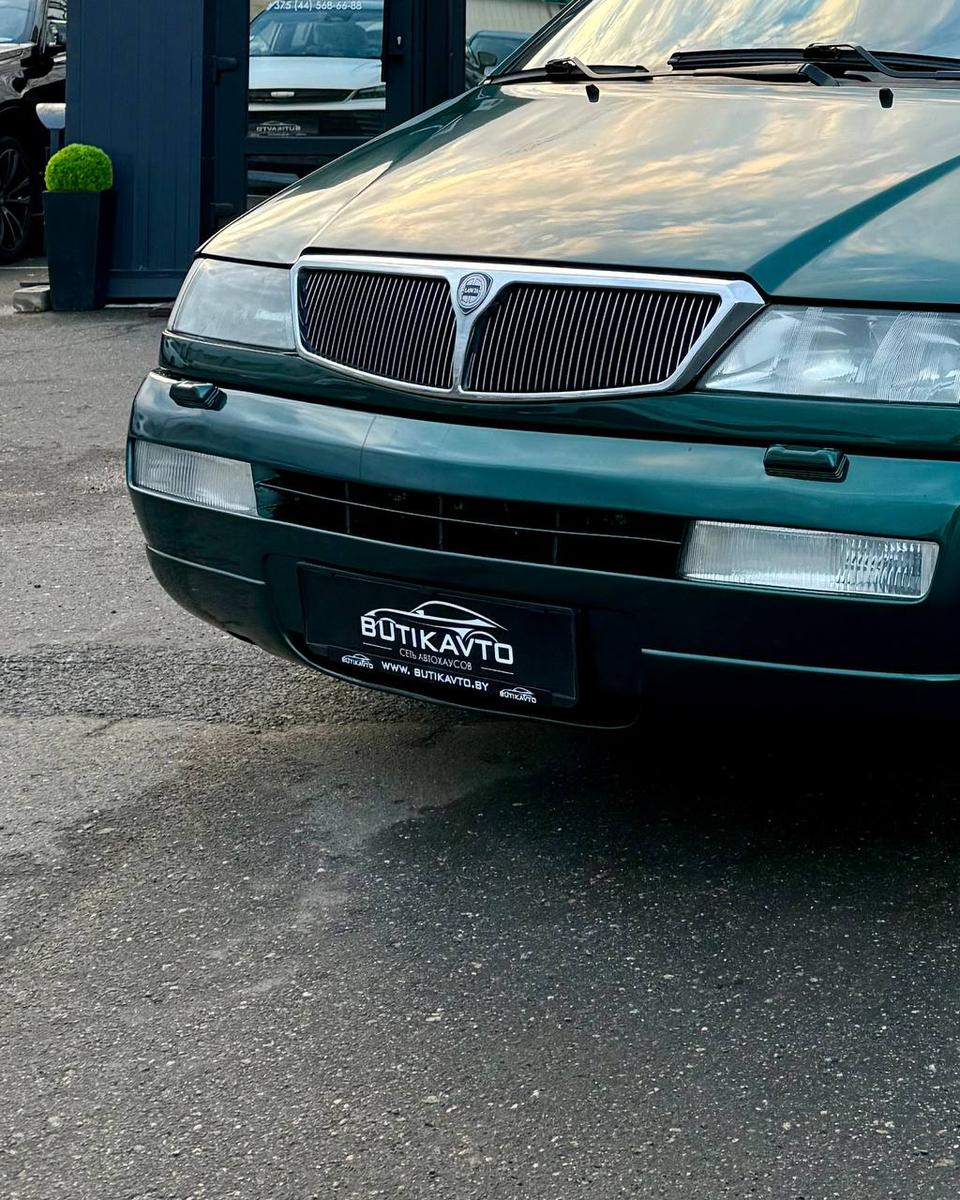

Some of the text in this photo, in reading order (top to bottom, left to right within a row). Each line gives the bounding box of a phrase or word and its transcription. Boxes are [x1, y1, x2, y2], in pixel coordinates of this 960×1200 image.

[294, 0, 313, 12] (44)
[360, 615, 515, 665] BUTIKAVTO
[418, 653, 473, 671] АВТОХАУСОВ
[381, 661, 490, 692] WWW. BUTIKAVTO.BY
